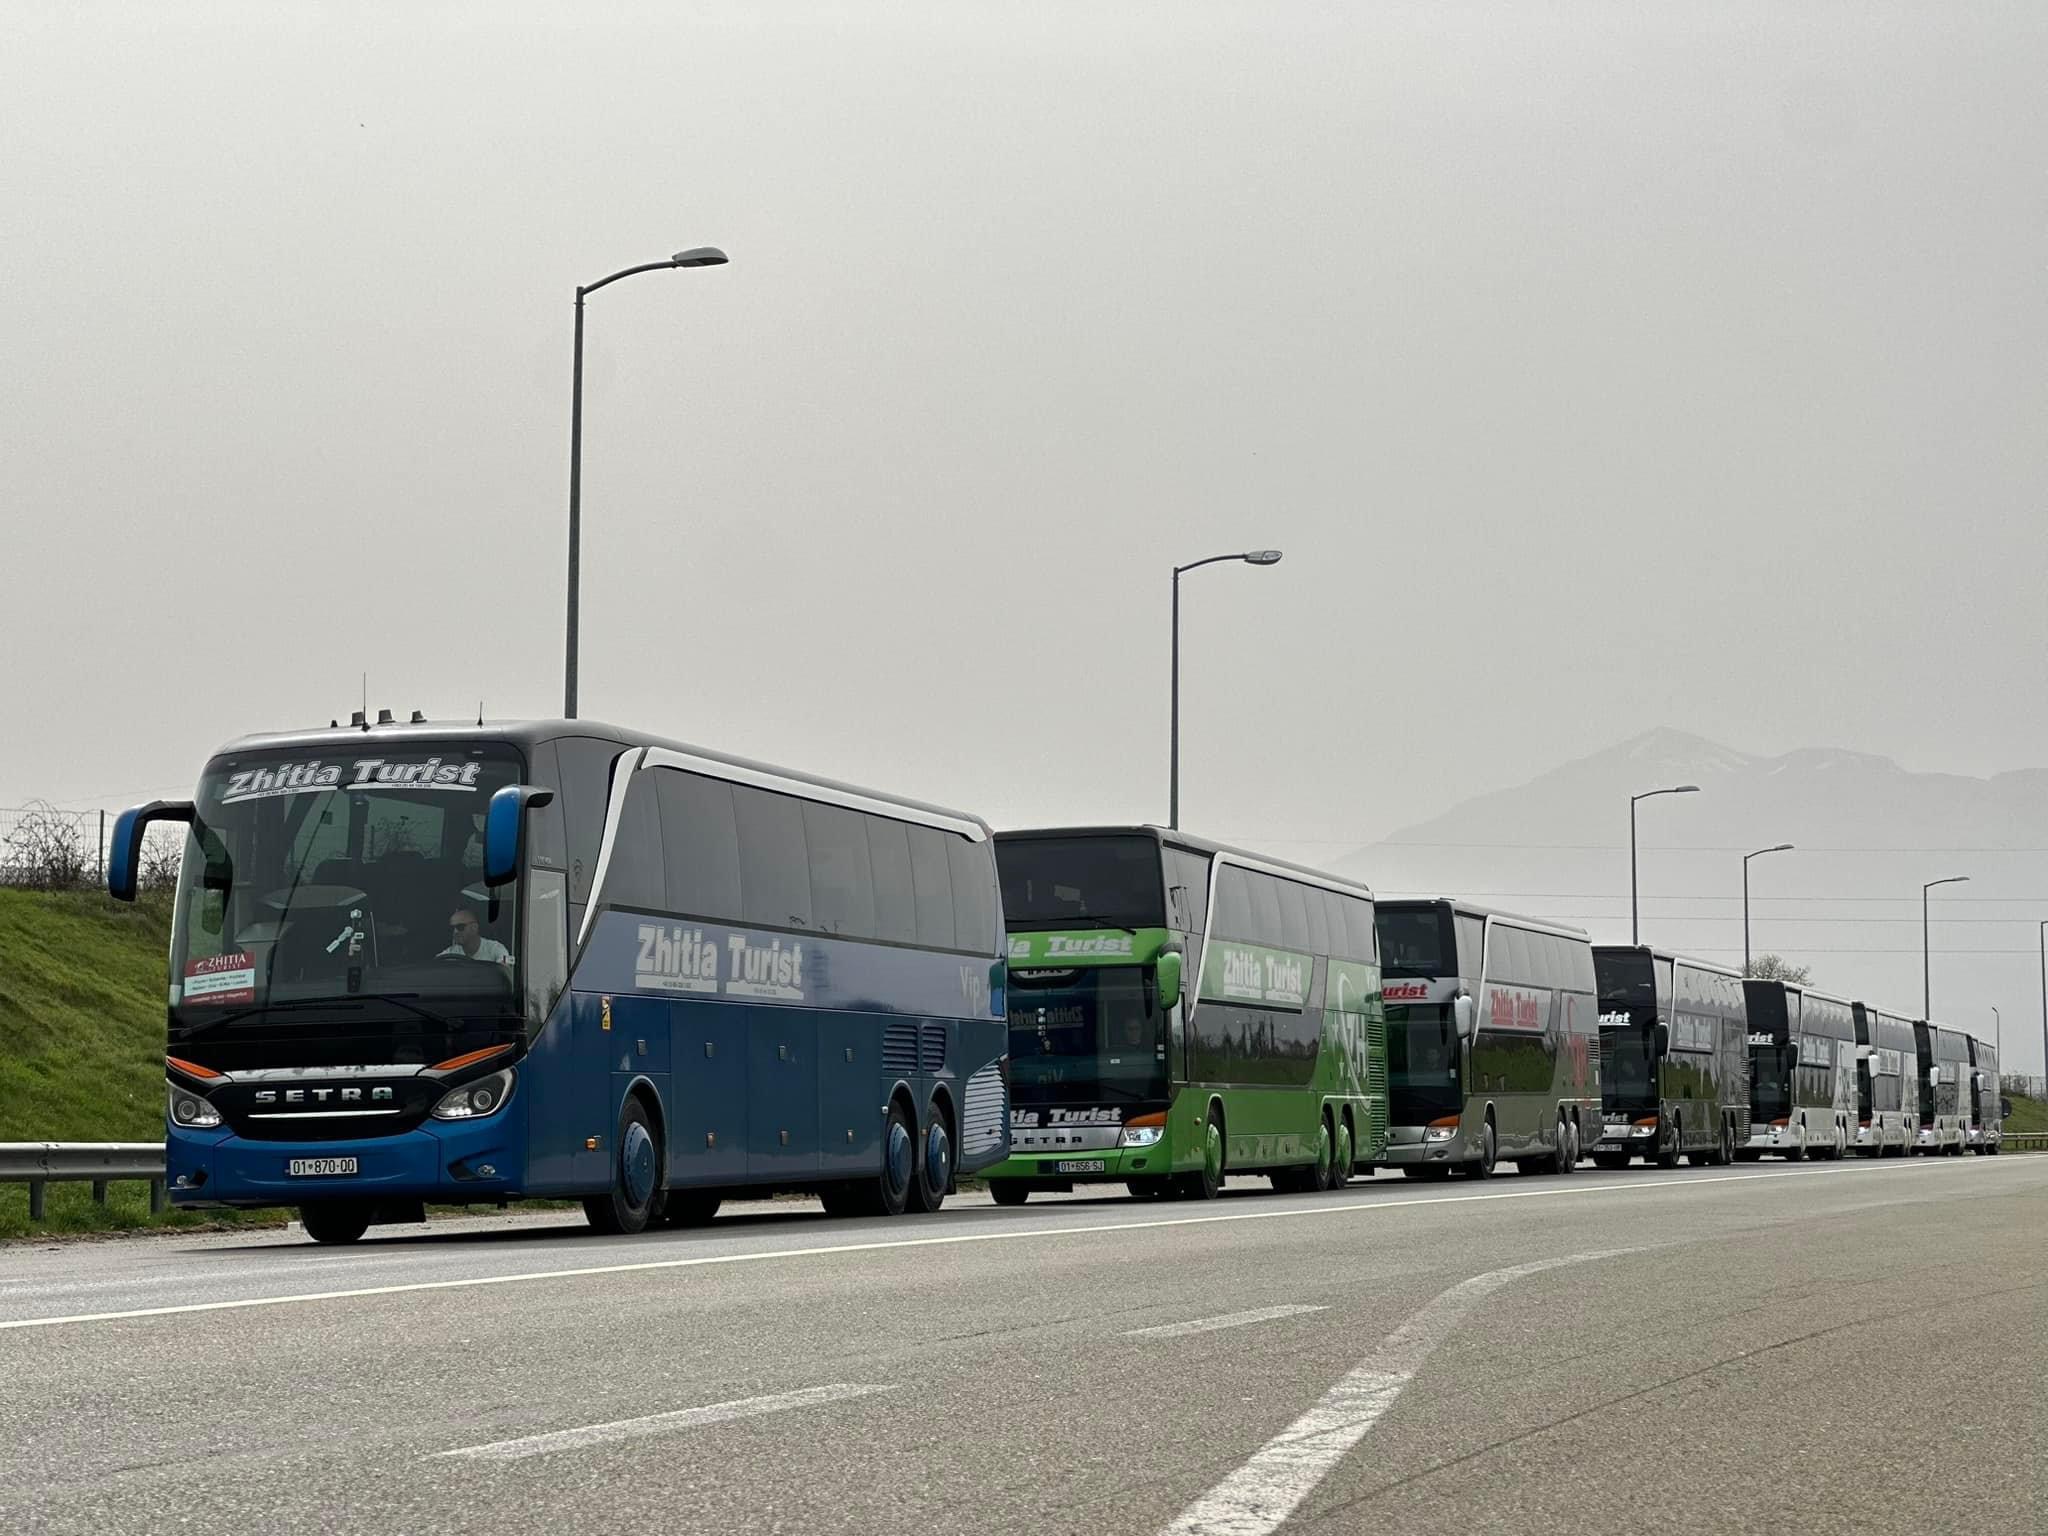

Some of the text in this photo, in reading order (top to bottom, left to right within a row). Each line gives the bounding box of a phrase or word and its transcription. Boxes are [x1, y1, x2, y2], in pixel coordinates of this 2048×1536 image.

[223, 757, 480, 798] Zhitia Turist
[1047, 935, 1133, 953] Turist
[208, 953, 247, 968] ZHITIA
[634, 923, 804, 989] Zhitia Turist
[1223, 948, 1302, 995] Zhitia Turist
[255, 1086, 393, 1104] SETRA
[1049, 1107, 1121, 1122] Turist
